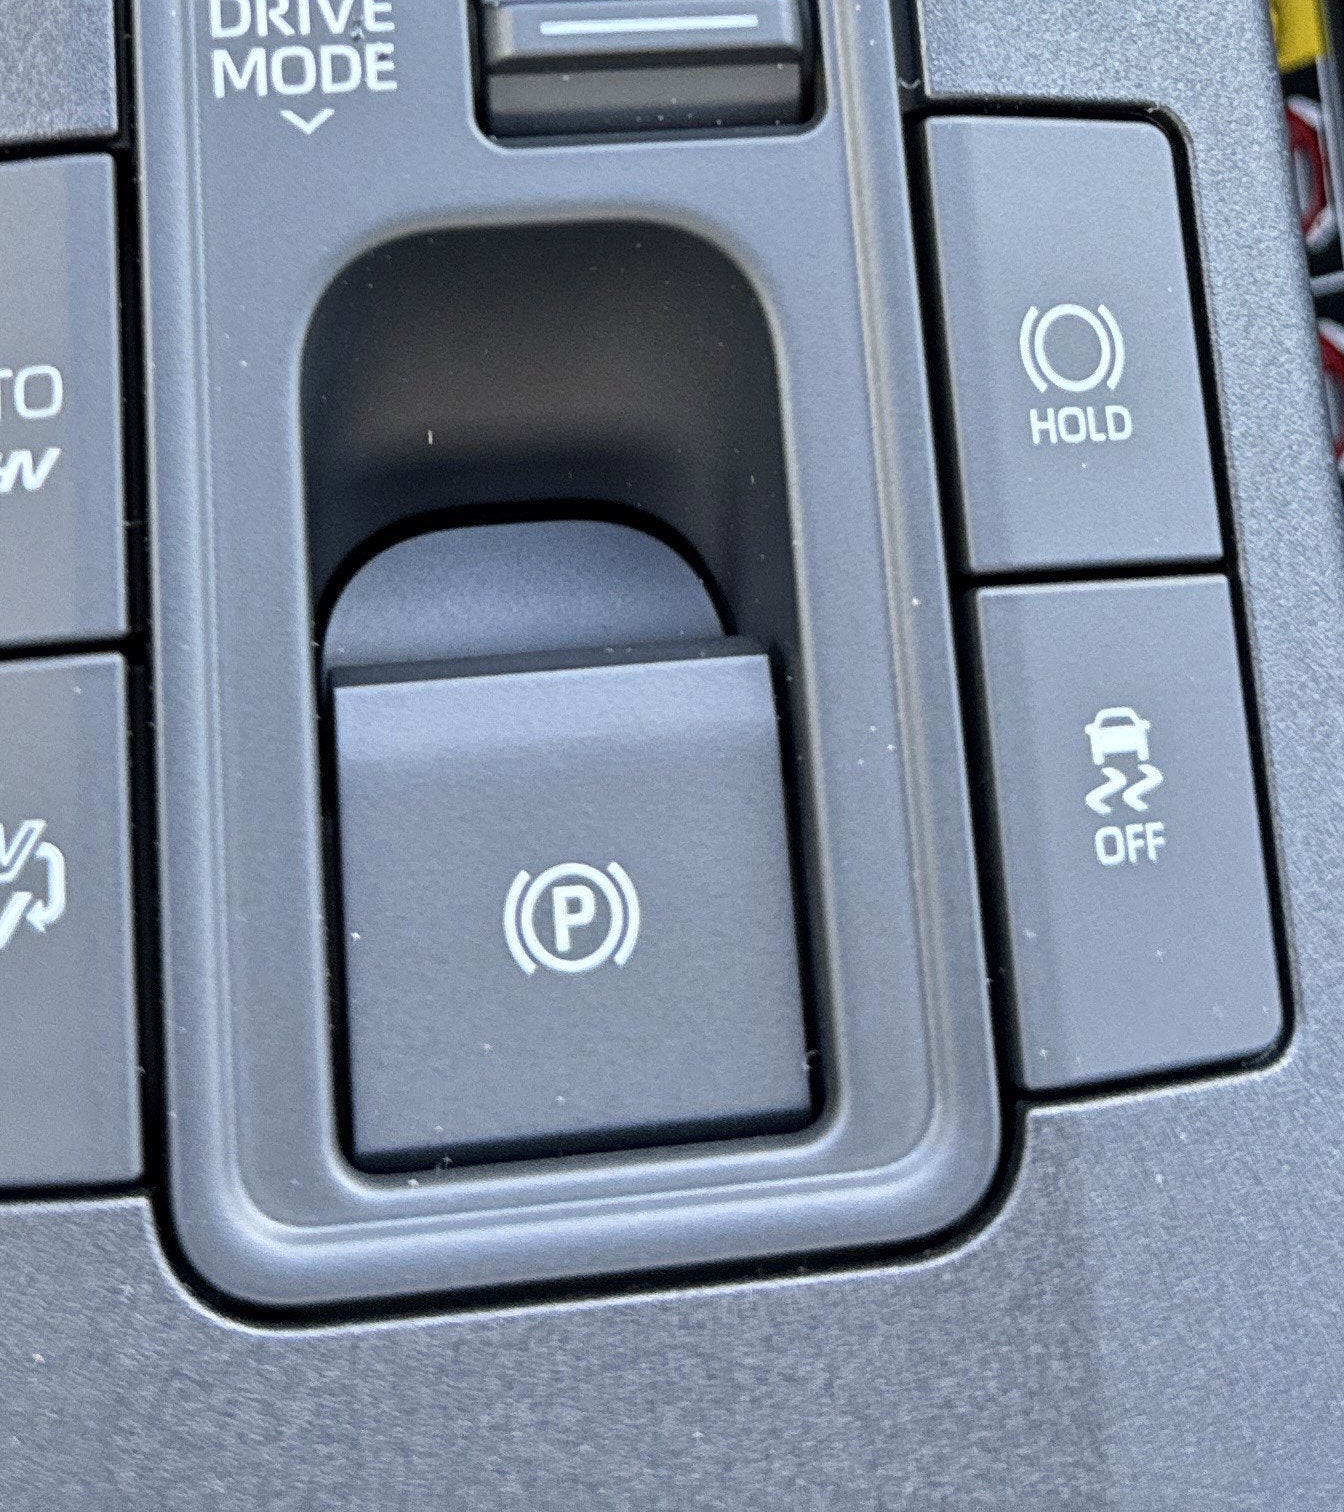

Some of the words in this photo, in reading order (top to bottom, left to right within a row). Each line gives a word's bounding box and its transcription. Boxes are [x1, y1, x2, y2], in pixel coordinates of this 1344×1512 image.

[212, 42, 398, 99] MODE
[1029, 404, 1133, 445] HOLD
[1094, 821, 1167, 866] OFF
